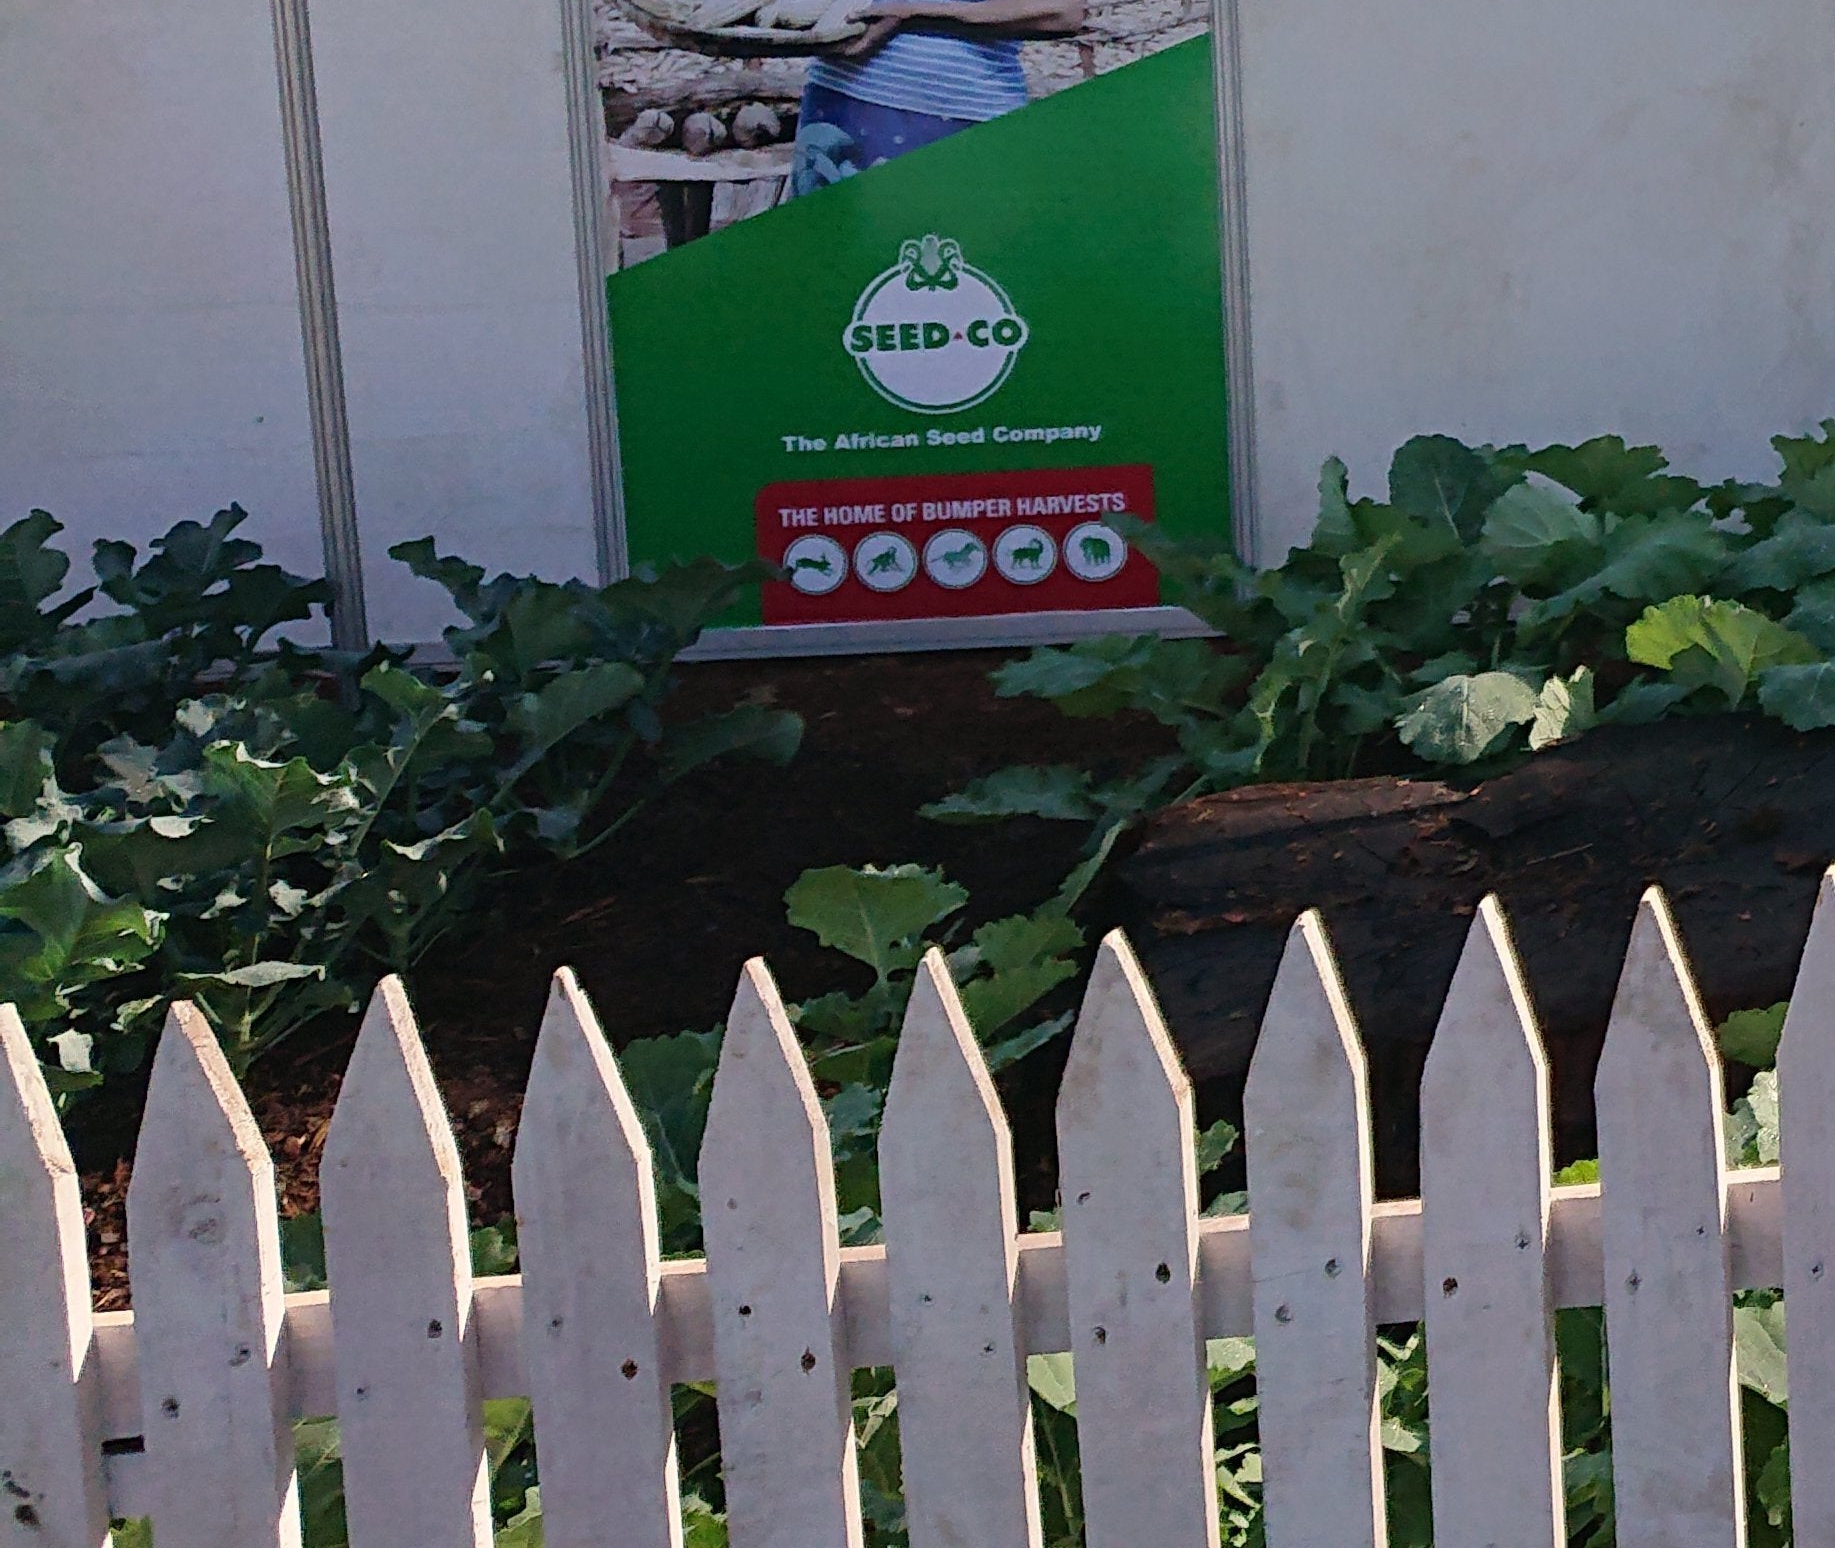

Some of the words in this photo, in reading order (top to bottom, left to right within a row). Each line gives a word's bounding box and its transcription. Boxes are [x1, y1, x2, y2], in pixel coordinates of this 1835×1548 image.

[851, 321, 950, 353] SEED
[967, 319, 1022, 348] CO
[780, 435, 826, 452] The
[834, 430, 918, 450] African
[926, 428, 985, 446] Seed
[993, 423, 1102, 443] Company
[779, 507, 818, 527] THE
[823, 504, 886, 525] HOME
[891, 501, 916, 522] OF
[923, 498, 1011, 520] BUMPER
[1017, 492, 1126, 515] HARVESTS
